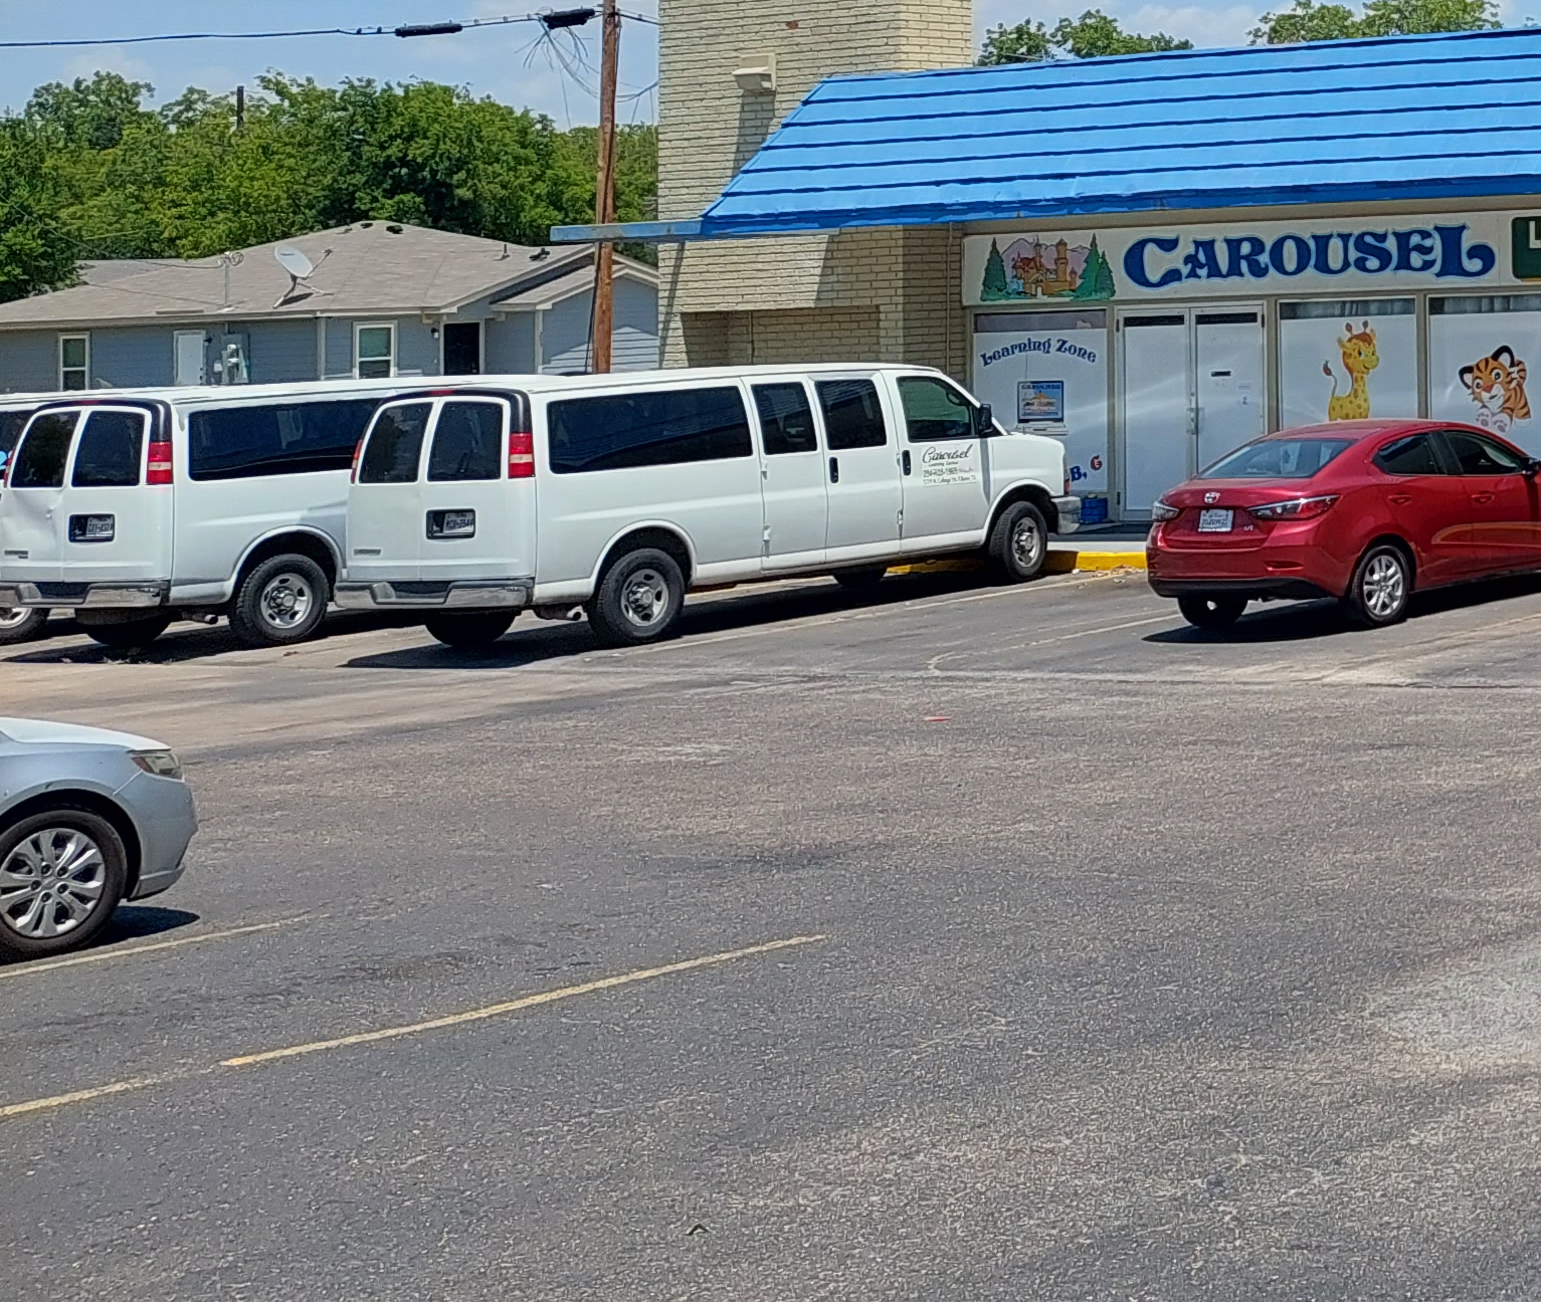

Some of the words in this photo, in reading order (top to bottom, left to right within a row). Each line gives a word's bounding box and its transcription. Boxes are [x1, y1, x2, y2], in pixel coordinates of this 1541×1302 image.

[1123, 224, 1496, 288] CAROUSEL
[980, 337, 1052, 367] Learning
[1055, 338, 1097, 364] Zone
